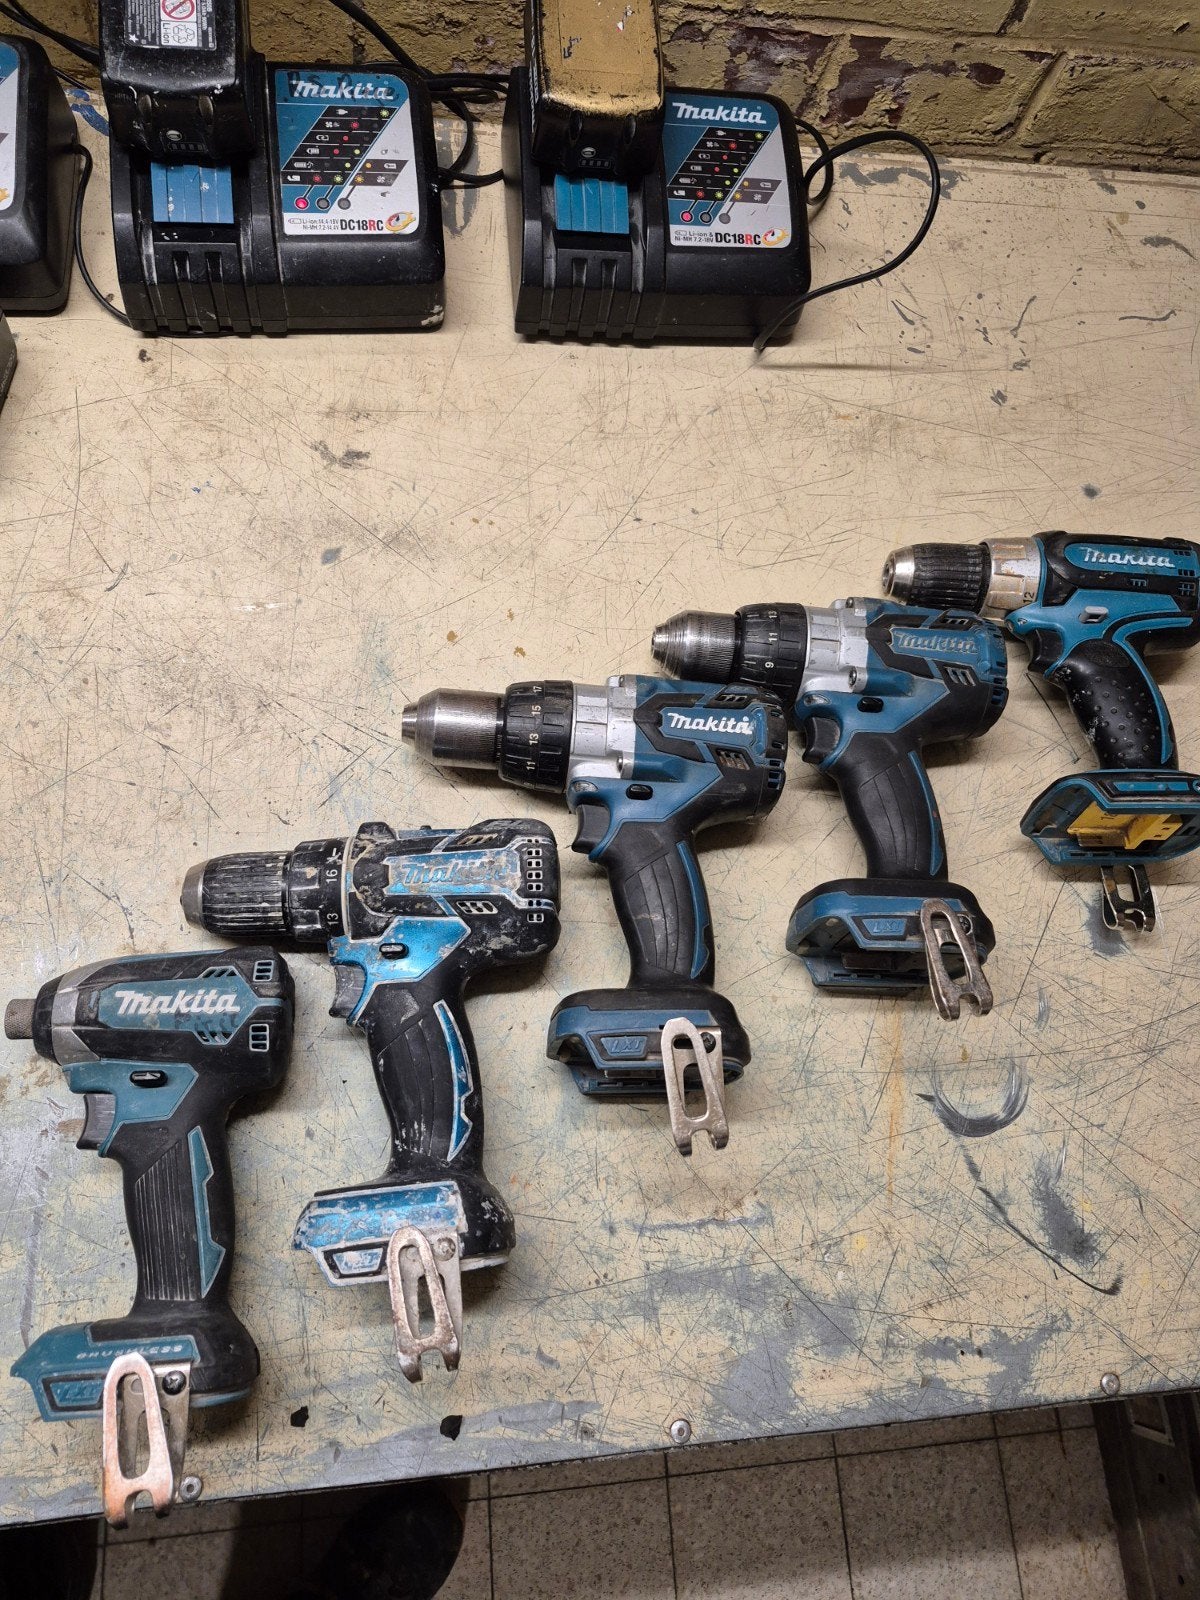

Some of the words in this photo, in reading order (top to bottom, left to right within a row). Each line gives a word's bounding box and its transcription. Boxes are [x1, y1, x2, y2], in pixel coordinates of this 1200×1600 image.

[340, 219, 384, 231] DC18RC
[715, 232, 762, 245] DC18RC
[1022, 591, 1035, 604] 12
[768, 610, 778, 619] 13
[768, 632, 778, 642] 11
[764, 661, 775, 669] 9
[533, 685, 542, 693] 17
[531, 705, 541, 716] 15
[528, 733, 539, 746] 13
[526, 761, 536, 771] 11
[325, 869, 338, 883] 16
[326, 913, 339, 926] 13
